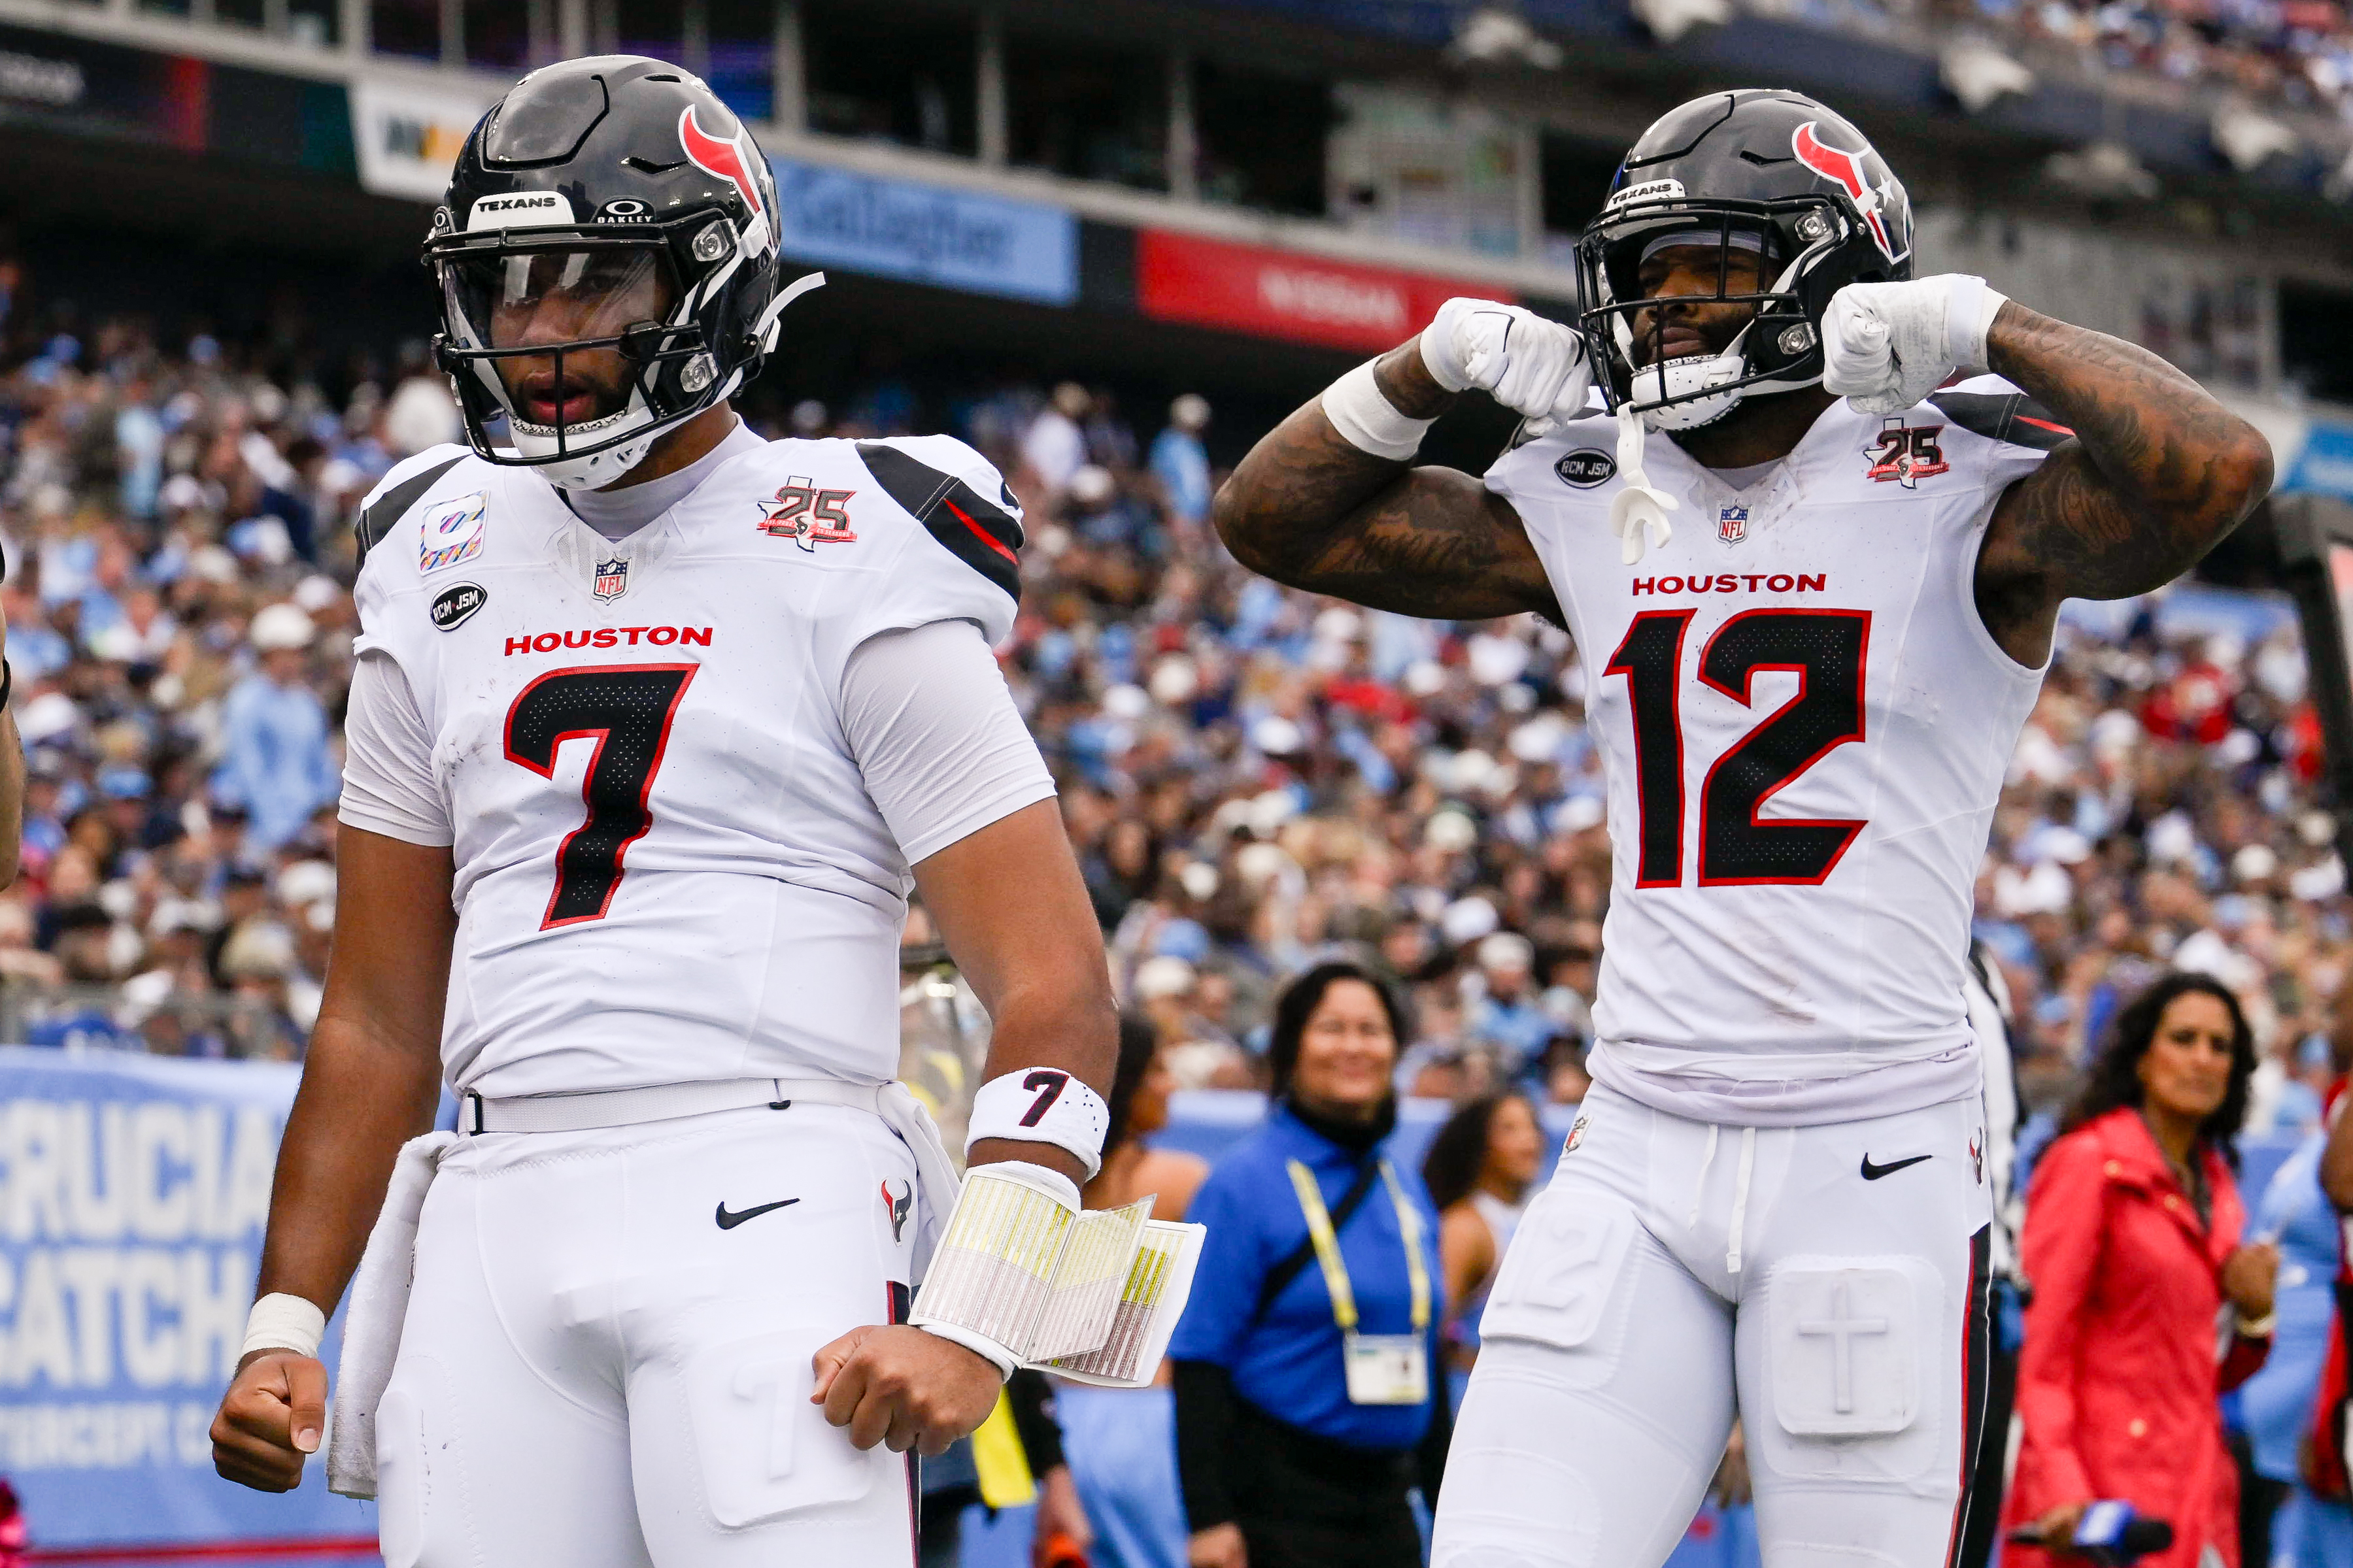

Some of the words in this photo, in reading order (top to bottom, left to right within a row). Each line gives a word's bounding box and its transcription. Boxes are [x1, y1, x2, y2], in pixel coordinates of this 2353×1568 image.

[477, 197, 556, 213] TEXANS
[1612, 183, 1672, 205] TEXANS
[1561, 460, 1585, 475] RCM
[1587, 462, 1612, 476] JSM
[1875, 424, 1946, 482] 25
[424, 494, 484, 552] C
[766, 486, 857, 542] 25
[1720, 521, 1743, 539] NFL
[433, 600, 452, 624] RCM
[456, 590, 479, 610] JSM
[596, 575, 623, 595] NFL
[1632, 573, 1827, 596] HOUSTON
[504, 626, 714, 657] HOUSTON
[1602, 608, 1872, 890] 12
[503, 663, 701, 931] 7
[1018, 1071, 1070, 1127] 7
[0, 1098, 280, 1242] RUCIA
[0, 1247, 252, 1391] ATCH
